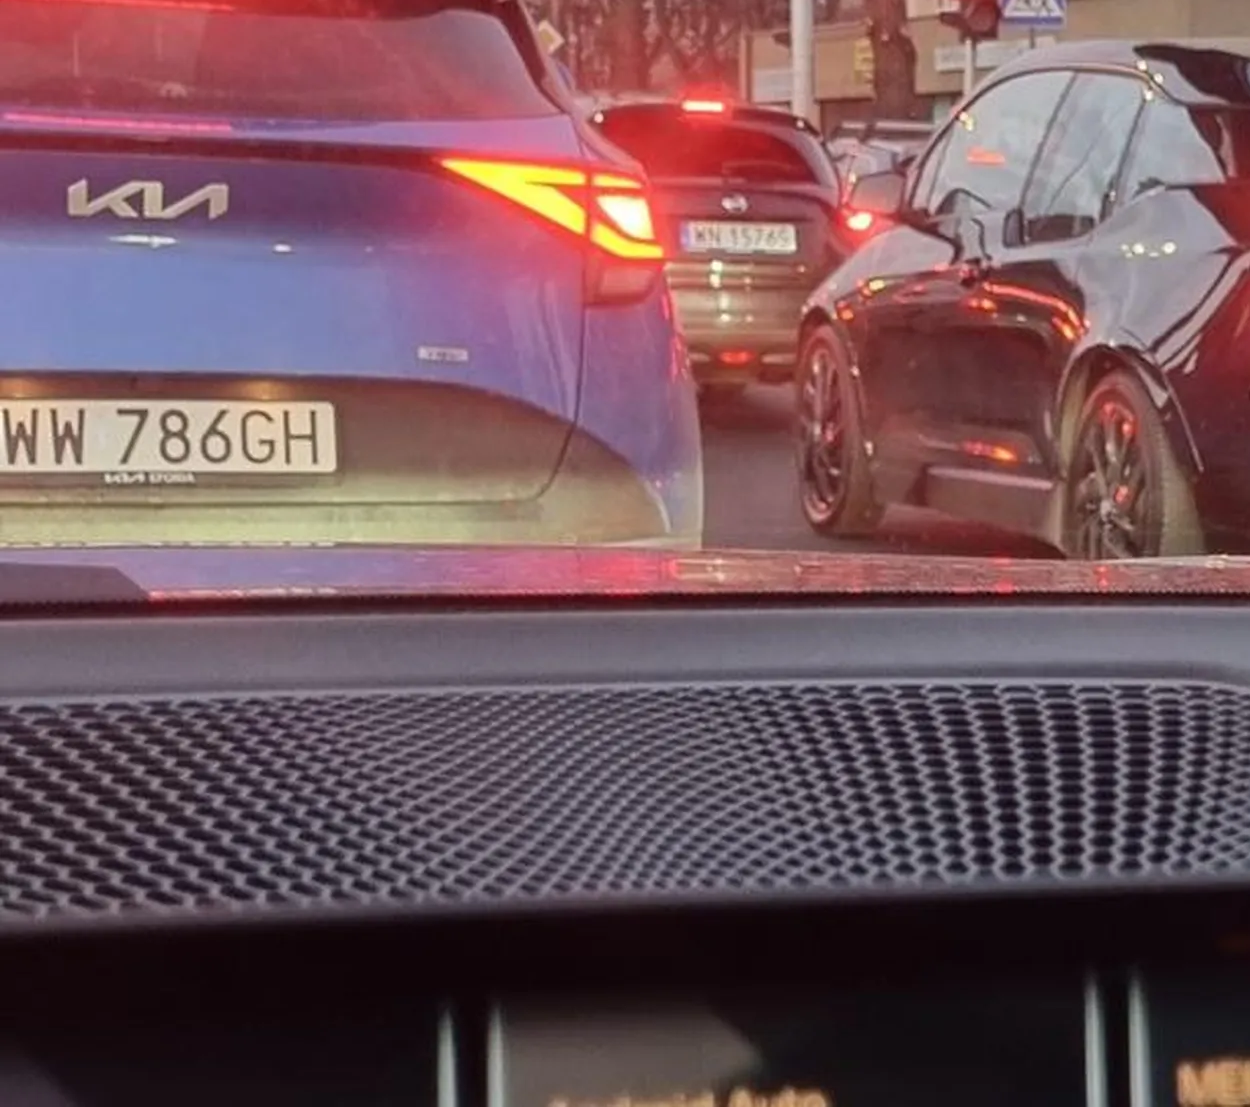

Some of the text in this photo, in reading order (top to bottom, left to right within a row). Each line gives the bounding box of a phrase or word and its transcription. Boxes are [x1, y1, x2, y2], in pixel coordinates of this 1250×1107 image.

[67, 177, 230, 221] KIA
[2, 408, 319, 466] WW 786GH
